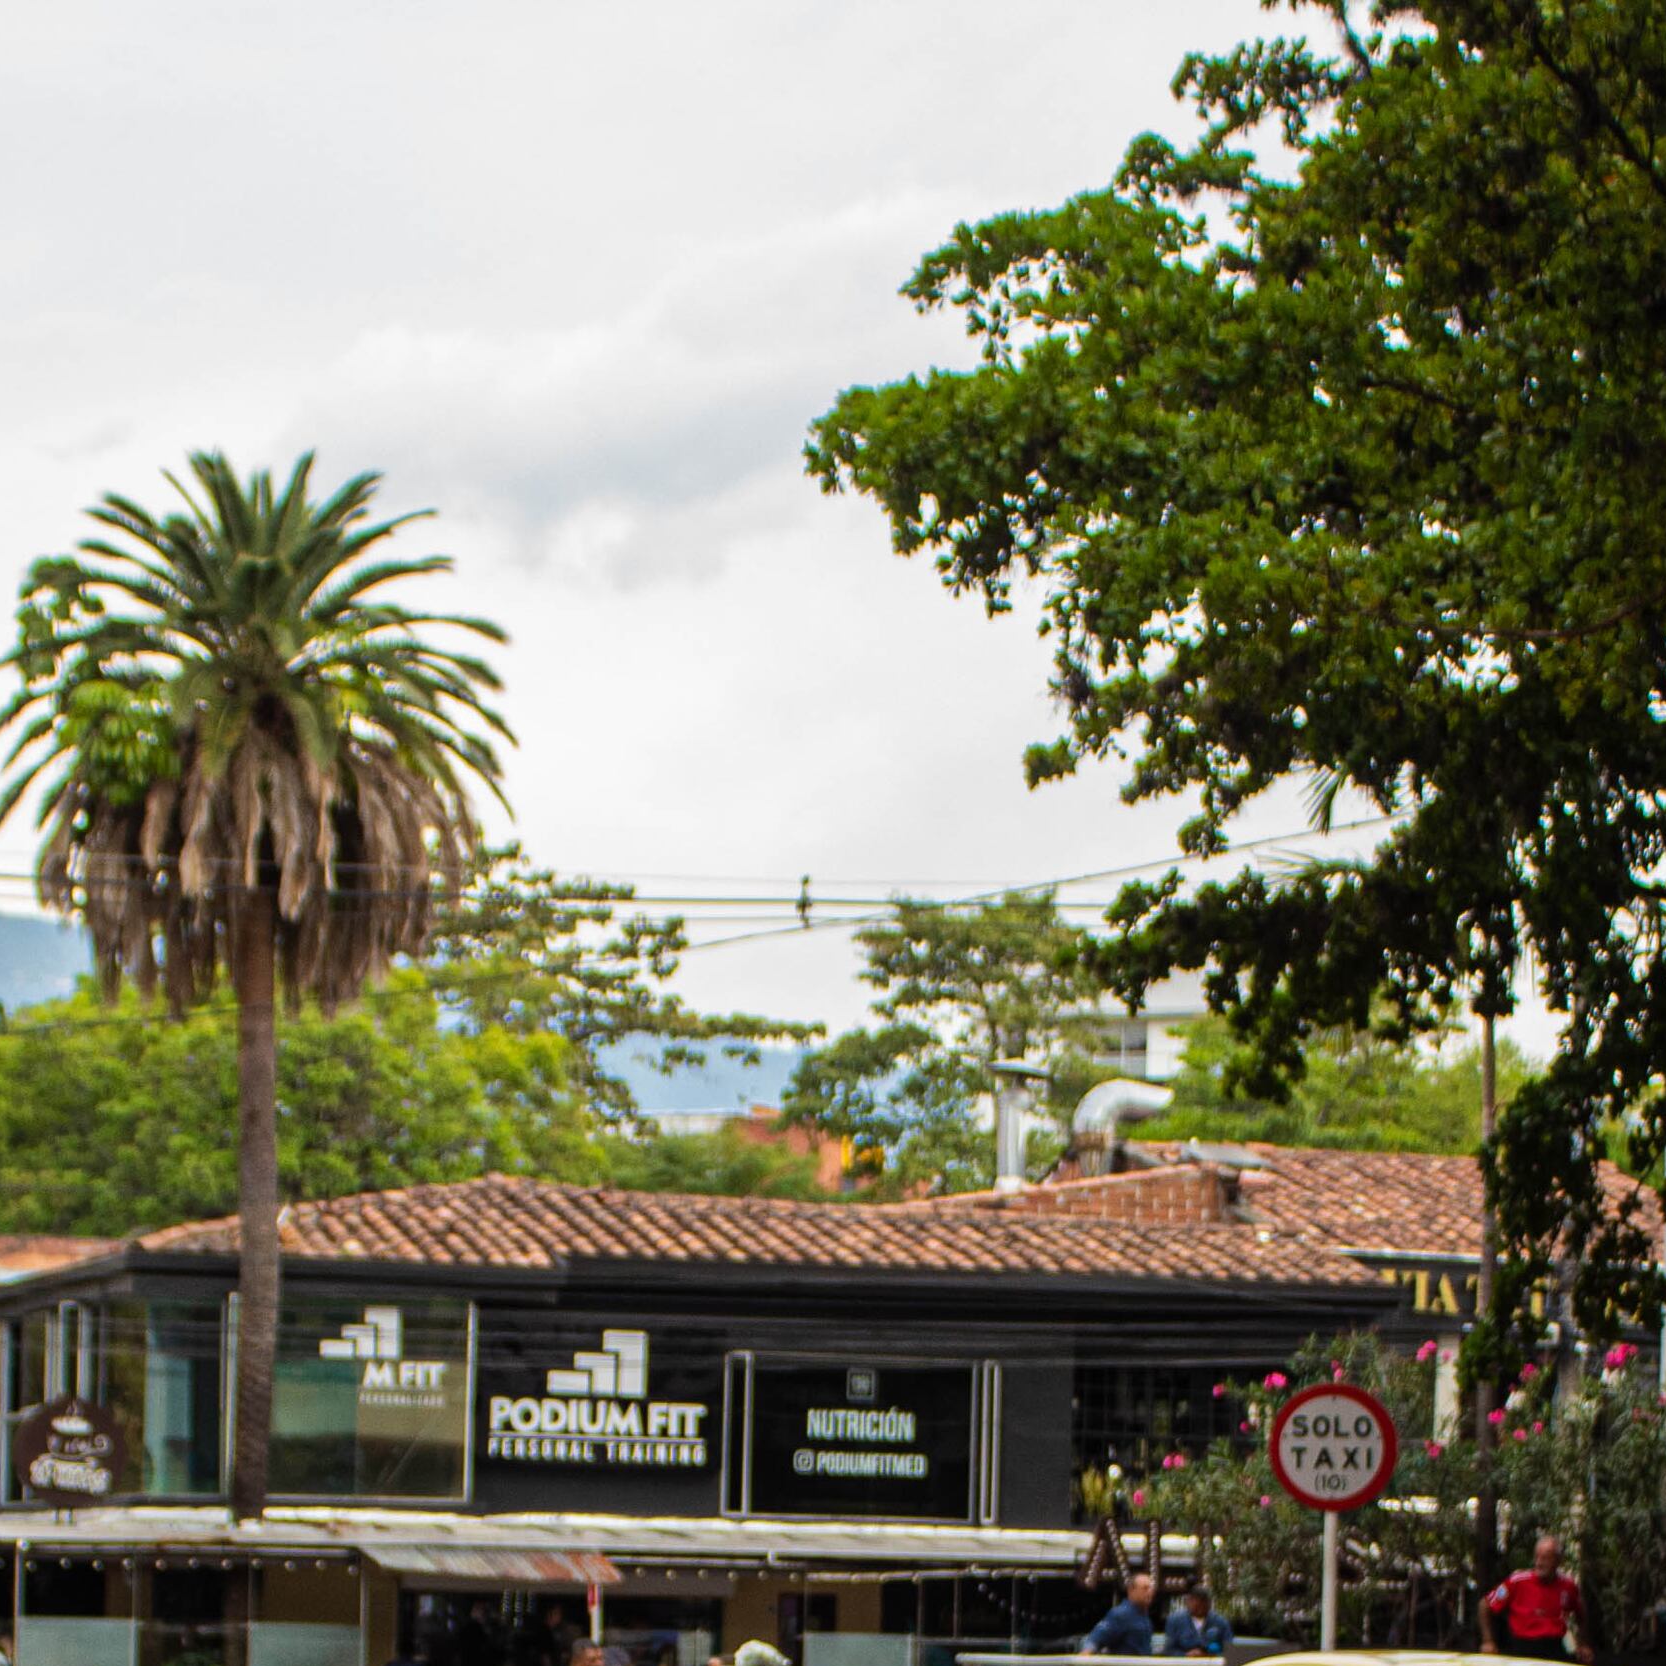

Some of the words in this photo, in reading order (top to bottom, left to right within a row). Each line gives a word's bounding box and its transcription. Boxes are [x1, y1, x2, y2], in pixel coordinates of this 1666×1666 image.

[399, 1360, 447, 1391] FIT
[489, 1395, 644, 1437] PODIUM
[647, 1401, 707, 1438] FIT
[806, 1406, 917, 1442] NUTRICIÓN
[1292, 1414, 1373, 1438] SOLO
[487, 1437, 597, 1463] PERSONAL
[607, 1441, 707, 1467] TRAINING
[817, 1450, 929, 1480] PODIUMFITMED
[1290, 1445, 1374, 1471] TAXI
